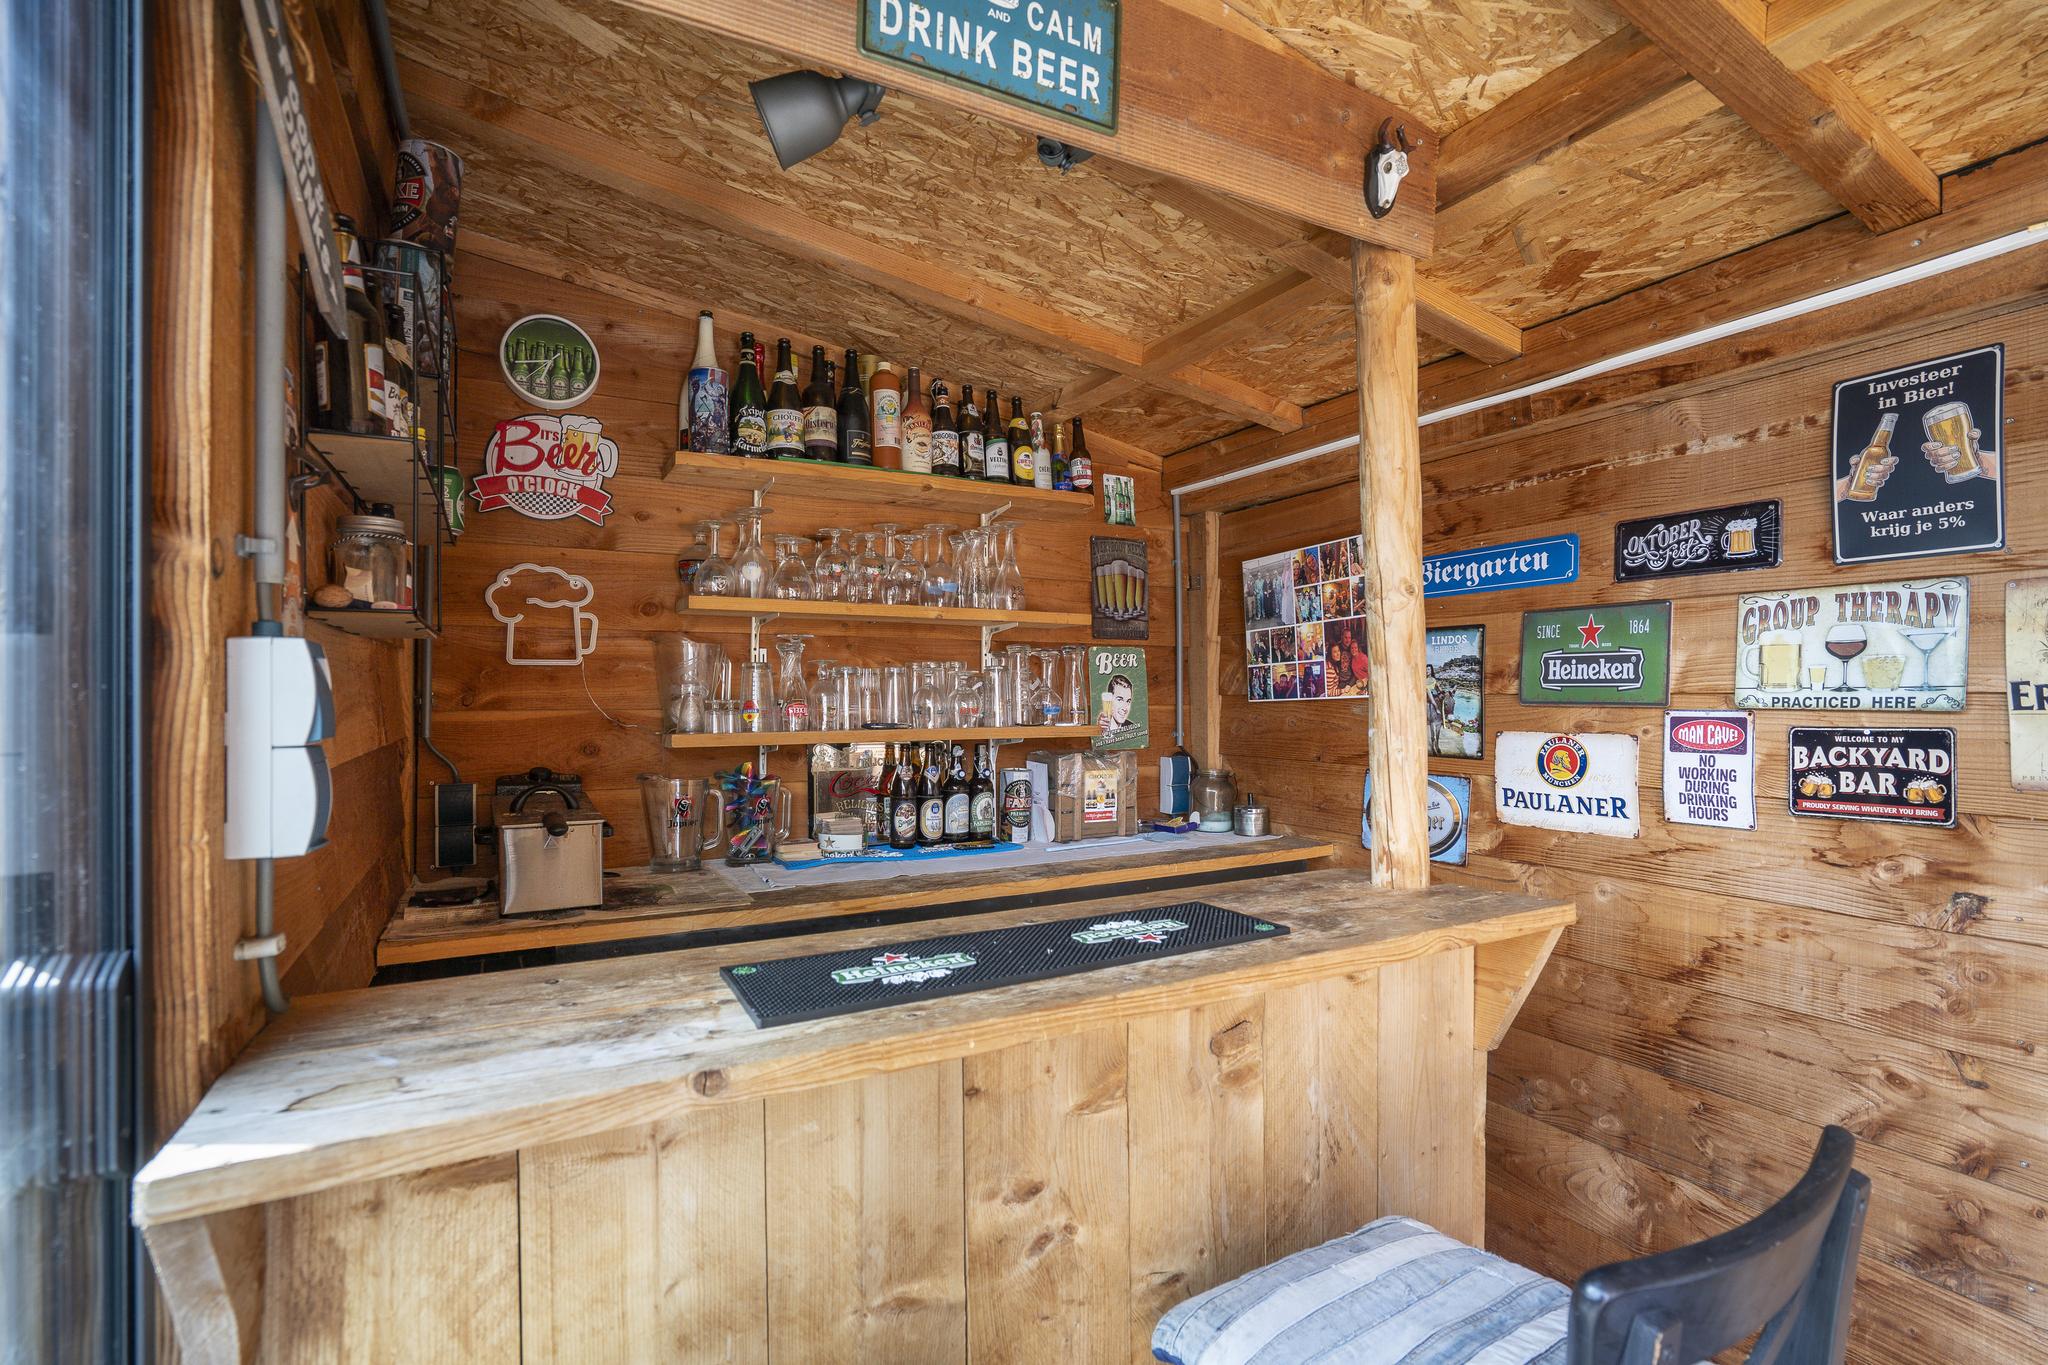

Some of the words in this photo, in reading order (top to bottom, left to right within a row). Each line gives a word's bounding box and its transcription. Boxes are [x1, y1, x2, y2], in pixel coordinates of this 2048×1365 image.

[987, 8, 1011, 23] AND
[1027, 1, 1102, 54] CALM
[879, 0, 998, 69] DRINK
[1012, 38, 1101, 104] BEER
[1867, 364, 1963, 396] Investeer
[1877, 397, 1898, 410] in
[1903, 381, 1954, 405] Bier!
[494, 419, 601, 476] Beer
[540, 431, 559, 442] IT'S
[506, 476, 582, 500] O'CLOCK
[1861, 509, 1907, 523] Waar
[1911, 500, 1975, 516] anders
[1870, 524, 1911, 538] krijg
[1914, 520, 1933, 536] je
[1938, 515, 1966, 530] 5%
[1624, 519, 1713, 558] OKTOBER
[1662, 538, 1711, 566] Fest
[1536, 624, 1561, 639] SINCE
[1629, 619, 1650, 634] 1864
[1742, 595, 1820, 646] GROUP
[1835, 591, 1961, 634] THERAPY
[1431, 634, 1468, 645] LINDOS
[1547, 658, 1635, 680] Heineken
[1771, 695, 1861, 709] PRACTICED
[1871, 696, 1917, 709] HERE
[1678, 724, 1704, 744] MAN
[1707, 724, 1738, 745] CAVE!
[1834, 735, 1875, 743] WELCOME
[1540, 737, 1585, 757] PAULANER
[1699, 754, 1716, 768] NO
[1792, 745, 1951, 775] BACKYARD
[1678, 766, 1737, 782] WORKING
[1838, 770, 1898, 796] BAR
[1684, 779, 1730, 795] DURING
[1501, 787, 1630, 819] PAULANER
[1678, 791, 1737, 809] DRINKING
[1802, 801, 1831, 809] PROUDLY
[1832, 804, 1860, 812] SERVING
[1861, 805, 1898, 814] WHATEVER
[1915, 809, 1939, 817] BRING
[1688, 805, 1729, 821] HOURS
[839, 953, 967, 981] Heineken
